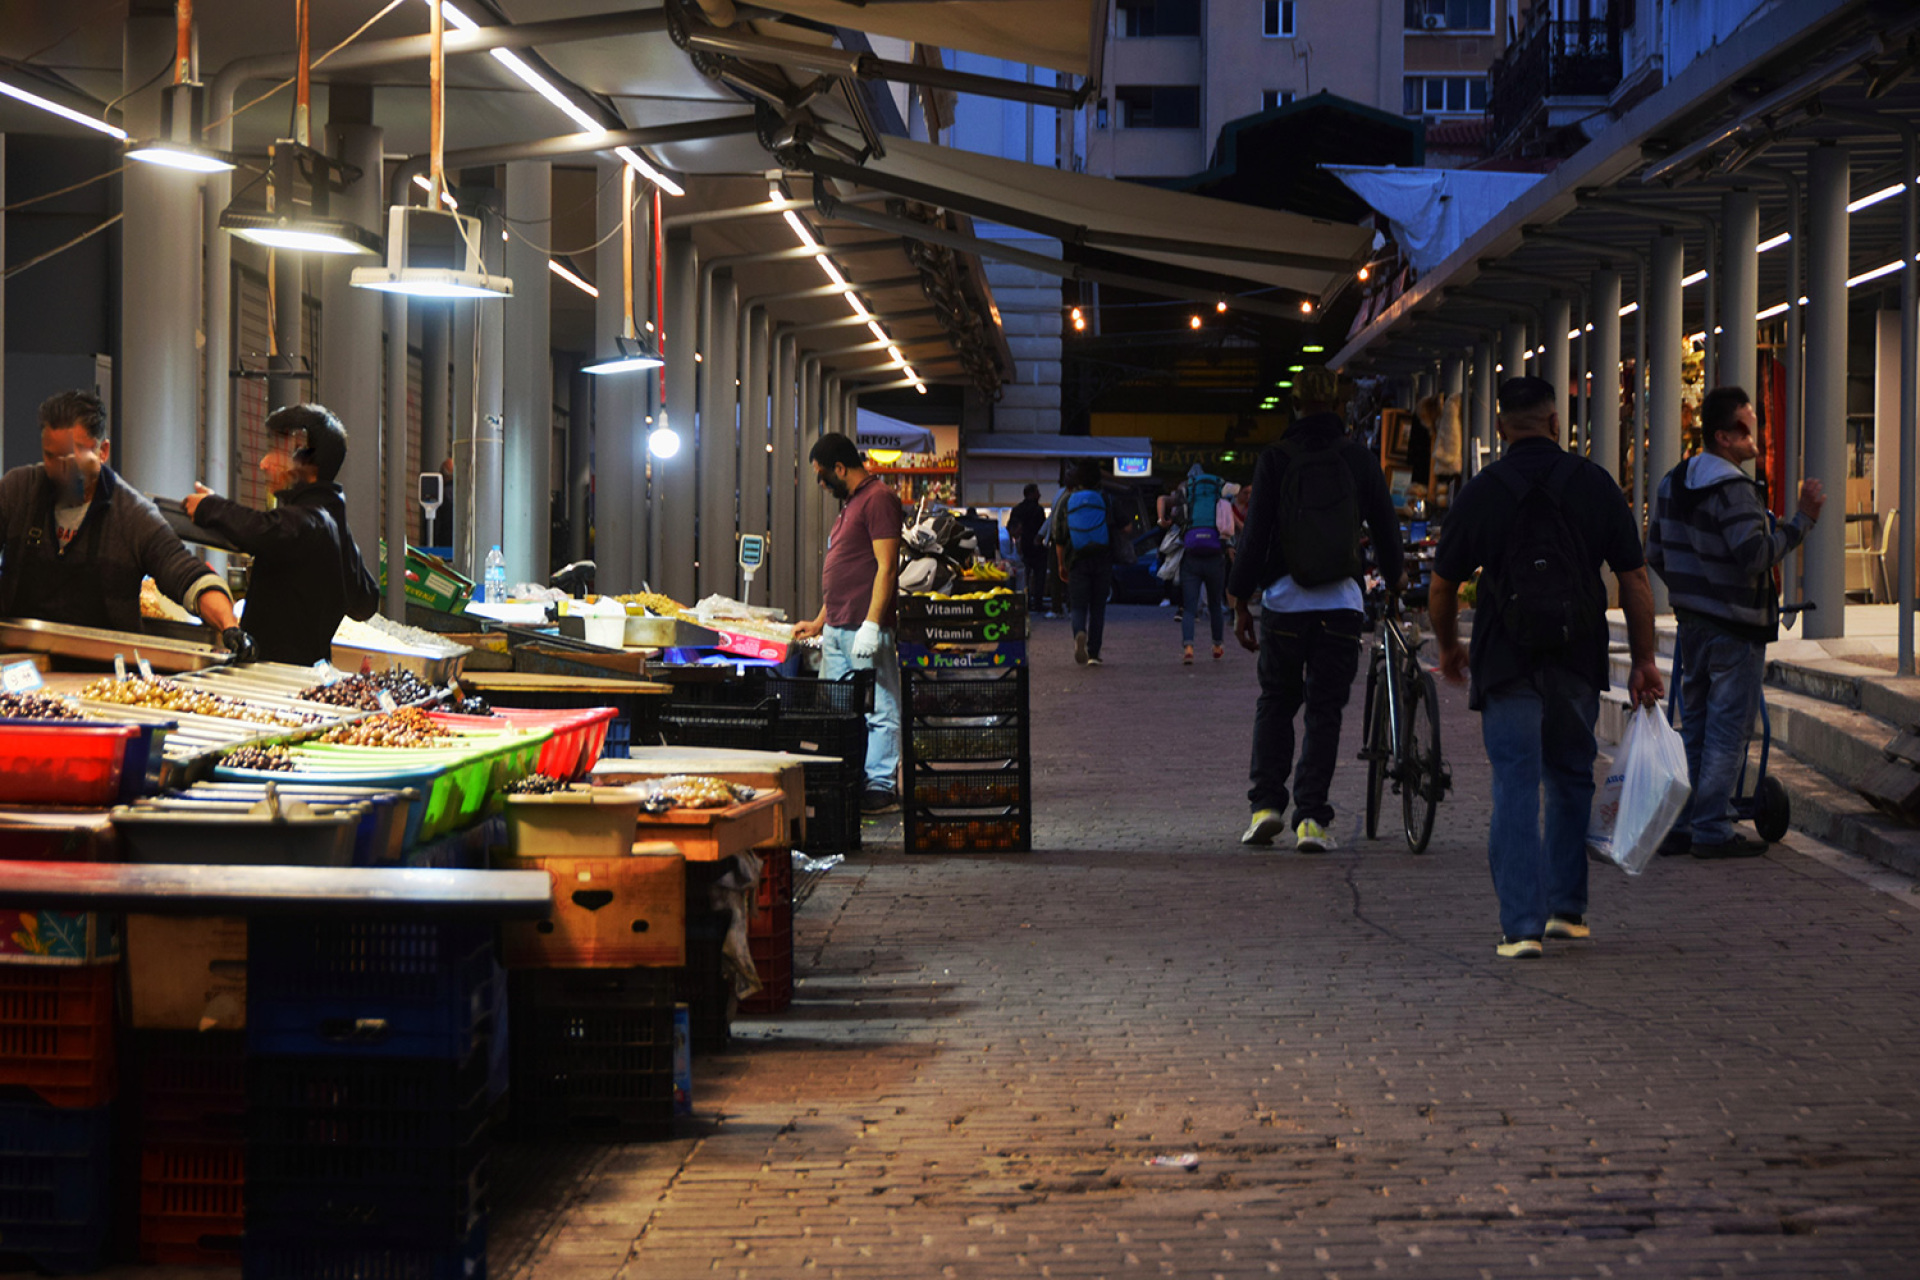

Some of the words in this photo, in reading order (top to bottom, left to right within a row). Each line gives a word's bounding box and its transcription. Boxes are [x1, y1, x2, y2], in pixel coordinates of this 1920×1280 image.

[925, 603, 974, 616] Vitamin
[983, 599, 1011, 617] C+
[925, 627, 973, 639] Vitamin
[983, 622, 1010, 641] C+
